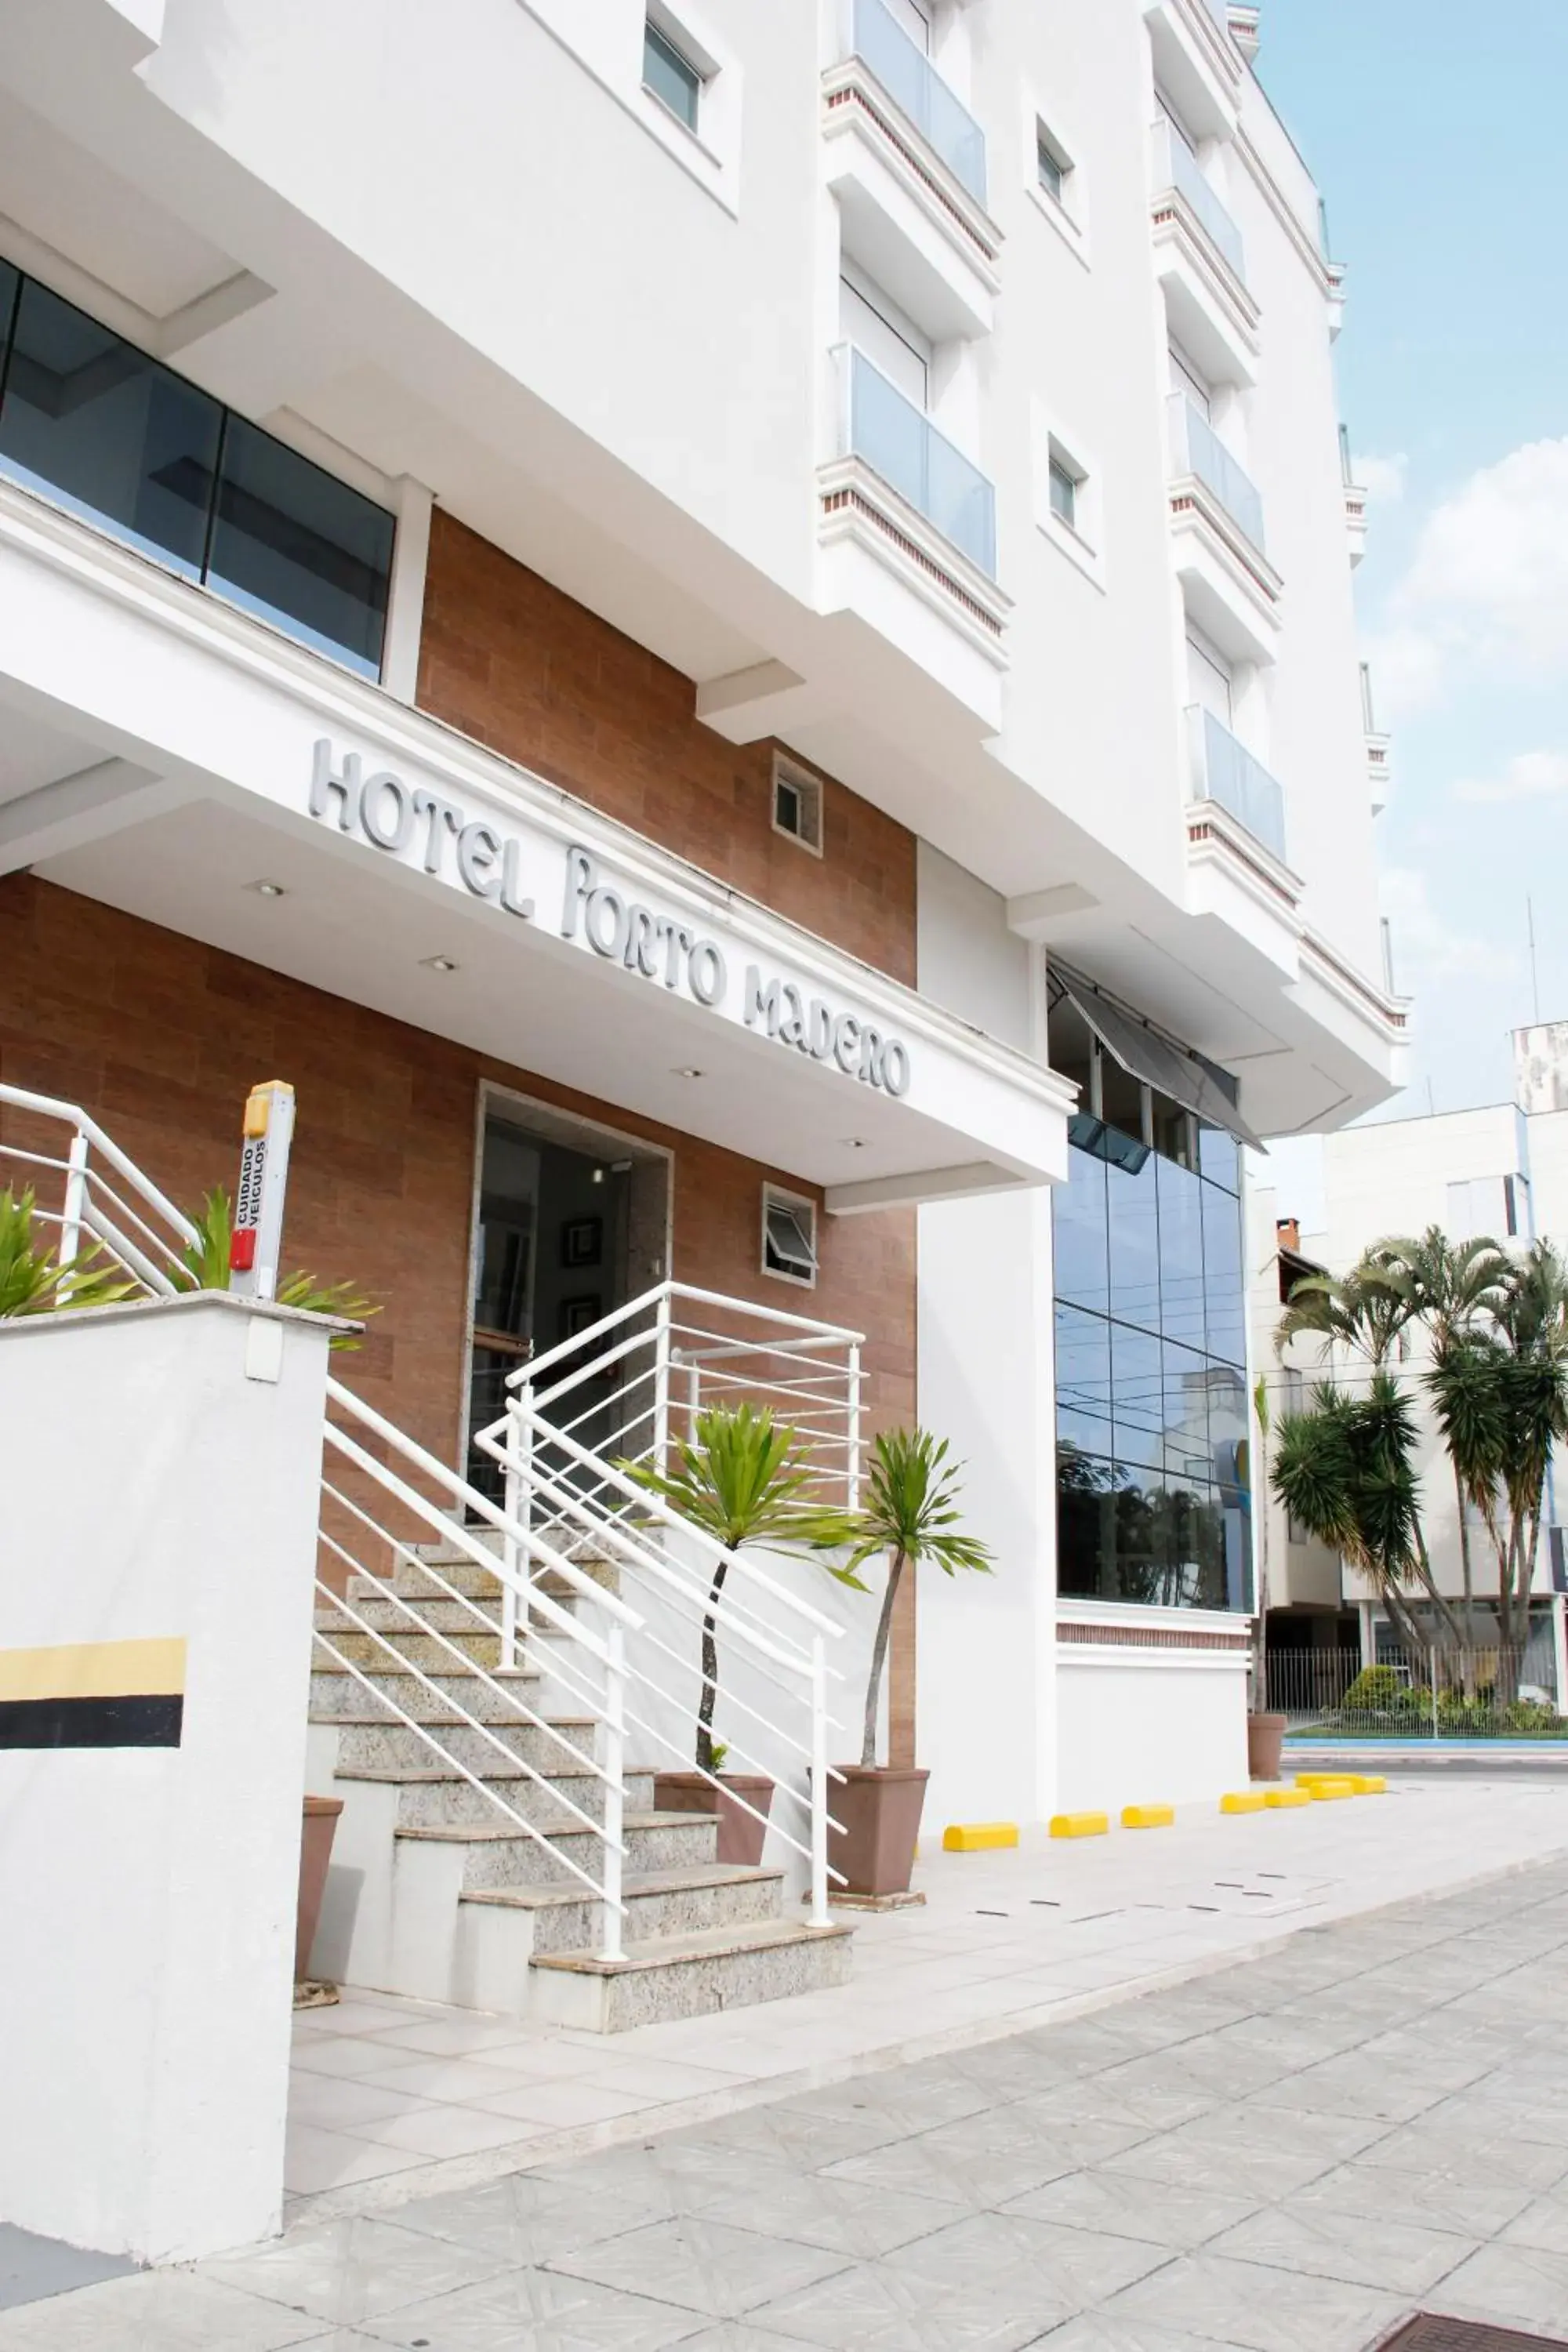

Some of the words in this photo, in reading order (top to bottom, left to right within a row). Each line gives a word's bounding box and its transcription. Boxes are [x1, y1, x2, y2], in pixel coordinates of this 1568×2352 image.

[309, 739, 535, 917] HOTEL
[561, 845, 727, 1005] PORTO
[238, 1149, 253, 1224] CUIDADO
[249, 1141, 265, 1226] VEICULOS
